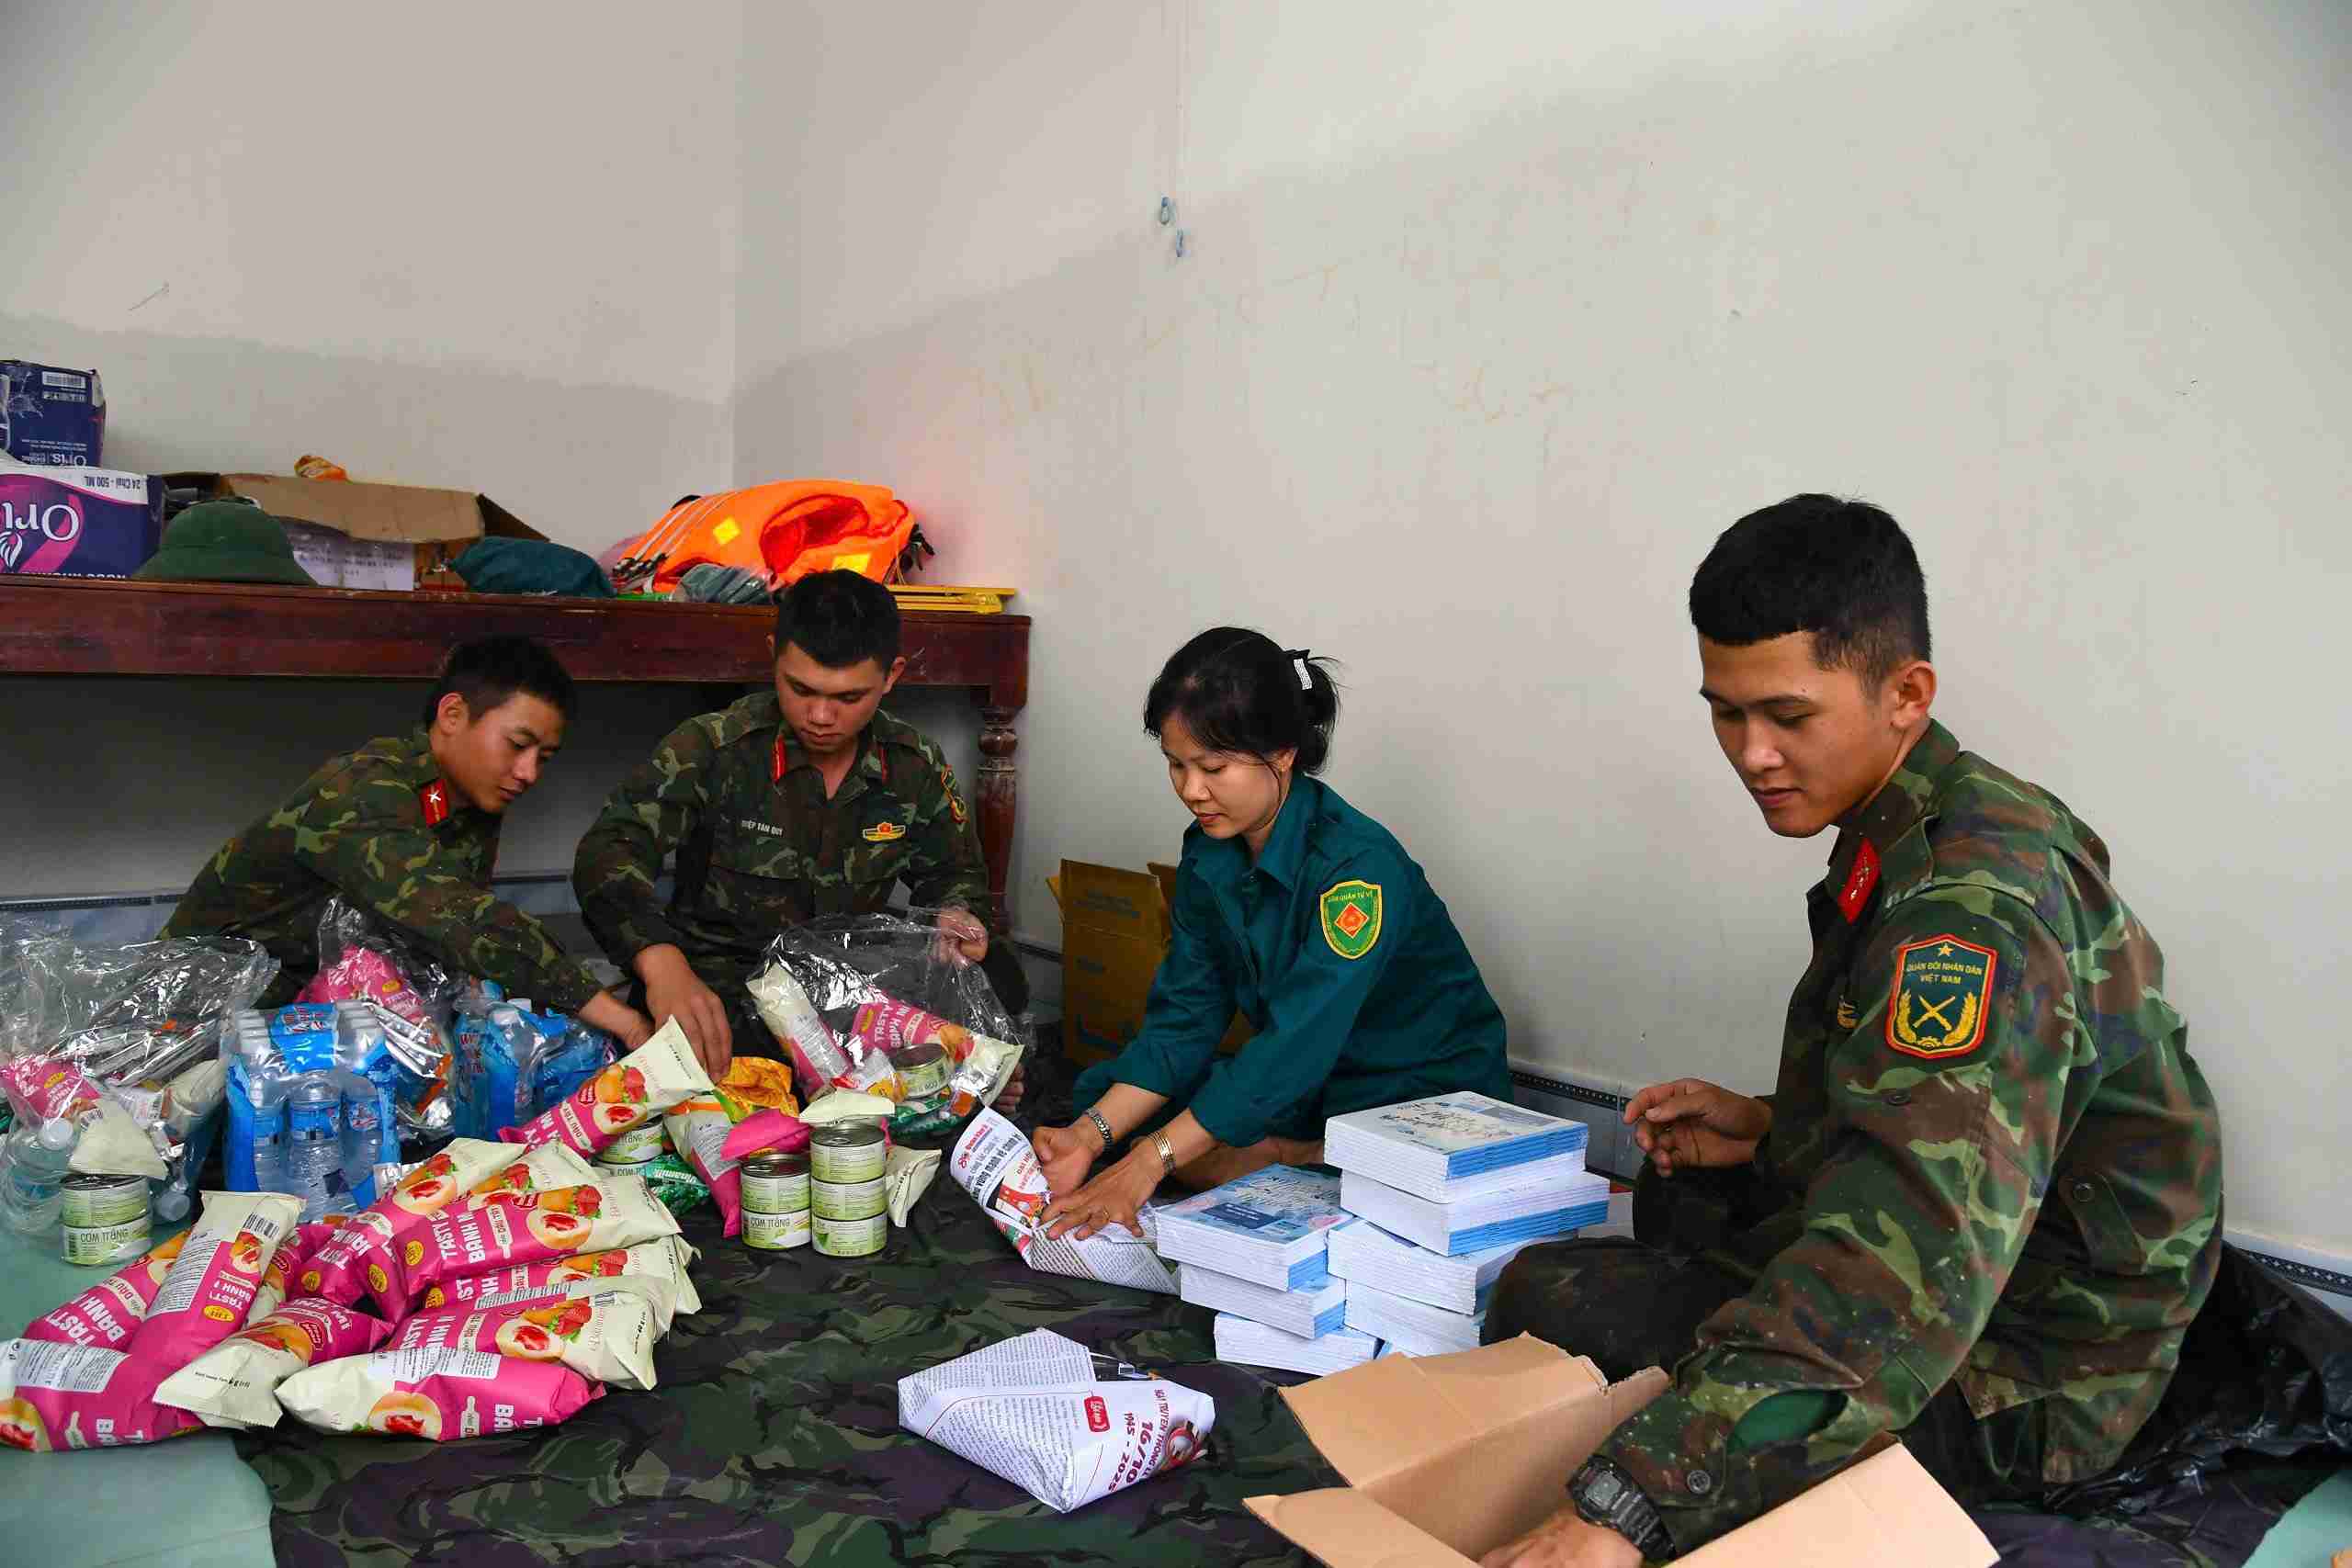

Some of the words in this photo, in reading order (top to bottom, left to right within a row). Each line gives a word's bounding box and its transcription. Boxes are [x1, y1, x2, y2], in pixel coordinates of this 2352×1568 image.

[96, 477, 109, 488] 500
[431, 1216, 459, 1261] TASTY
[458, 1220, 486, 1263] BÁNH
[1125, 1420, 1154, 1484] 16/10
